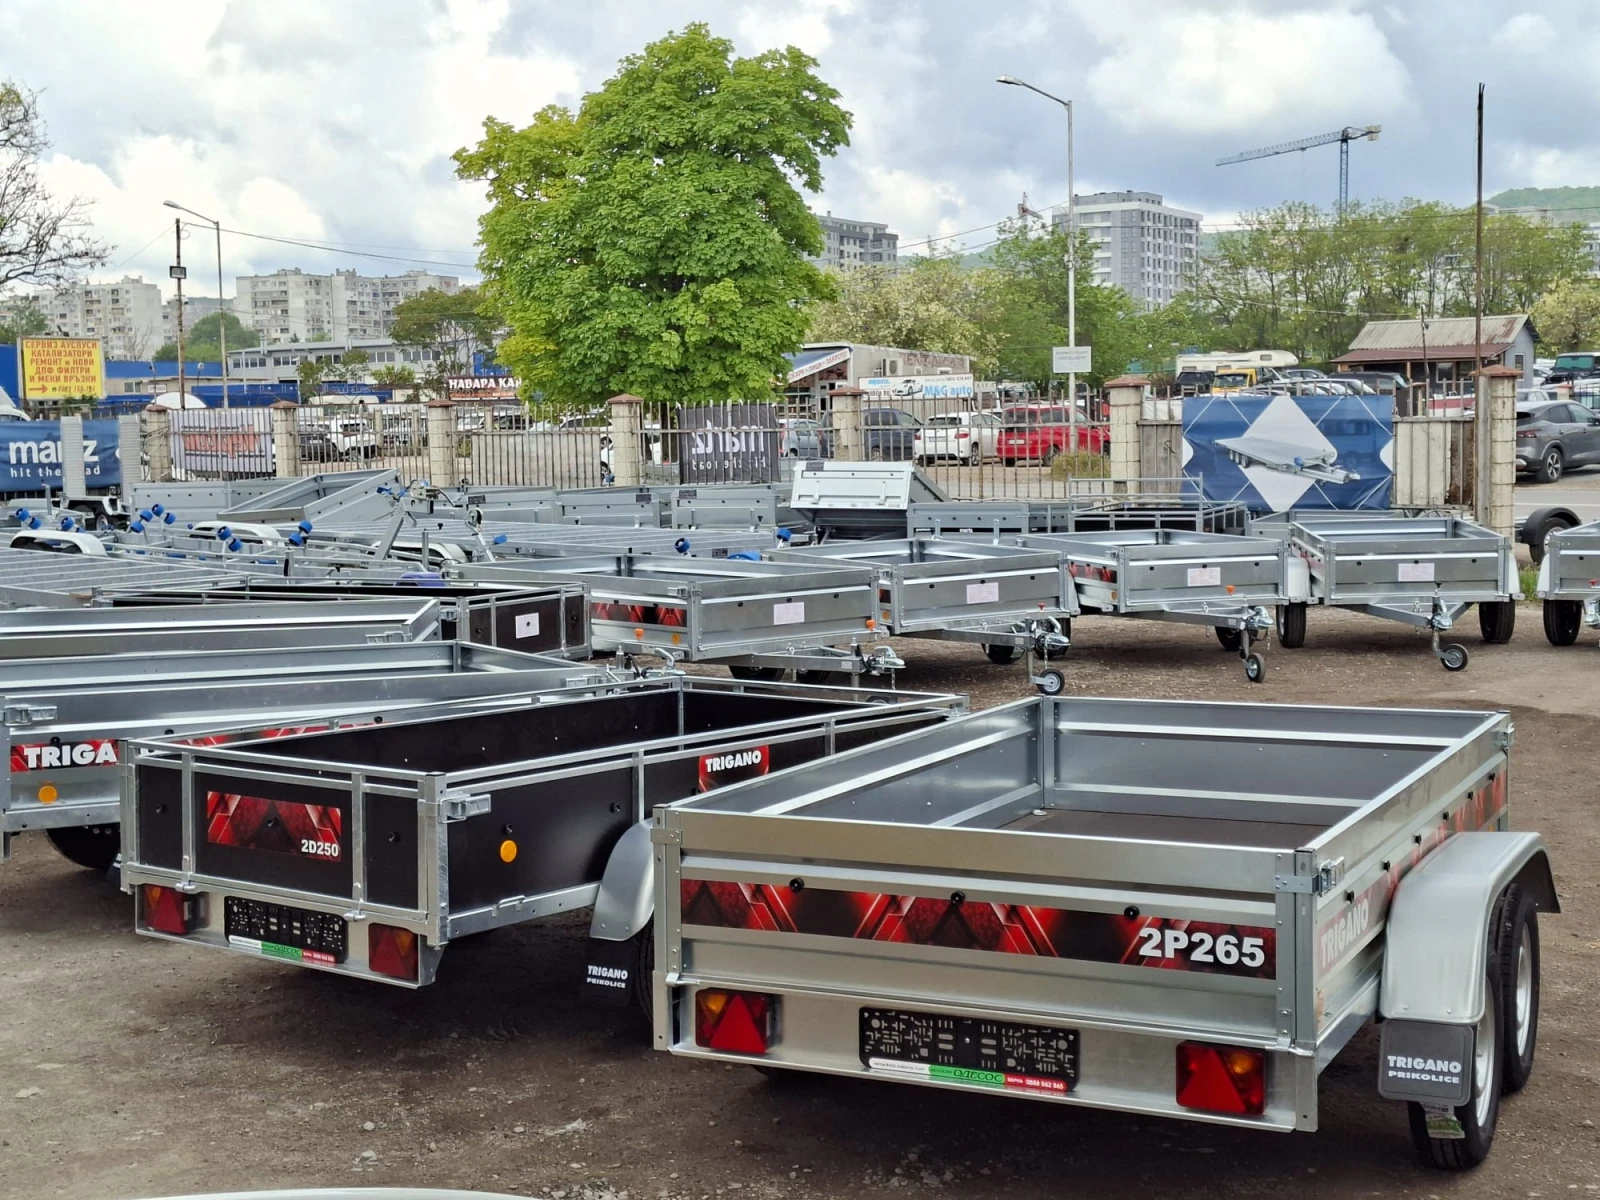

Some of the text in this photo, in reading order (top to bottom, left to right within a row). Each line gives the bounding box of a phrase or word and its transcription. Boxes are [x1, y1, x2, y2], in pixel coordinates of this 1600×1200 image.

[25, 340, 97, 349] СЕРВИЗ АУСПУСИ
[31, 349, 93, 357] КАТАЛИЗАТОРИ
[30, 357, 63, 366] РЕМОНТ
[72, 357, 94, 366] НОВИ
[34, 366, 91, 375] ДПФ ФИЛТРИ
[29, 375, 97, 383] И МЕКИ ВРЪЗКИ
[448, 378, 496, 389] НАВАРА
[924, 385, 947, 396] M&G
[950, 385, 973, 396] auto
[9, 440, 99, 464] maz
[10, 465, 101, 477] hit the ad
[24, 743, 118, 769] TRIGA
[705, 750, 762, 773] TRIGANO
[301, 839, 339, 857] 2D250
[1321, 898, 1369, 969] TRIGANO
[1138, 927, 1265, 968] 2P265
[587, 965, 629, 980] TRIGANO
[586, 977, 626, 989] PRIKOLICE
[1387, 1055, 1462, 1074] TRIGANO
[953, 1070, 1003, 1082] ОДЕСОС
[1388, 1070, 1460, 1084] PRIKOLICE
